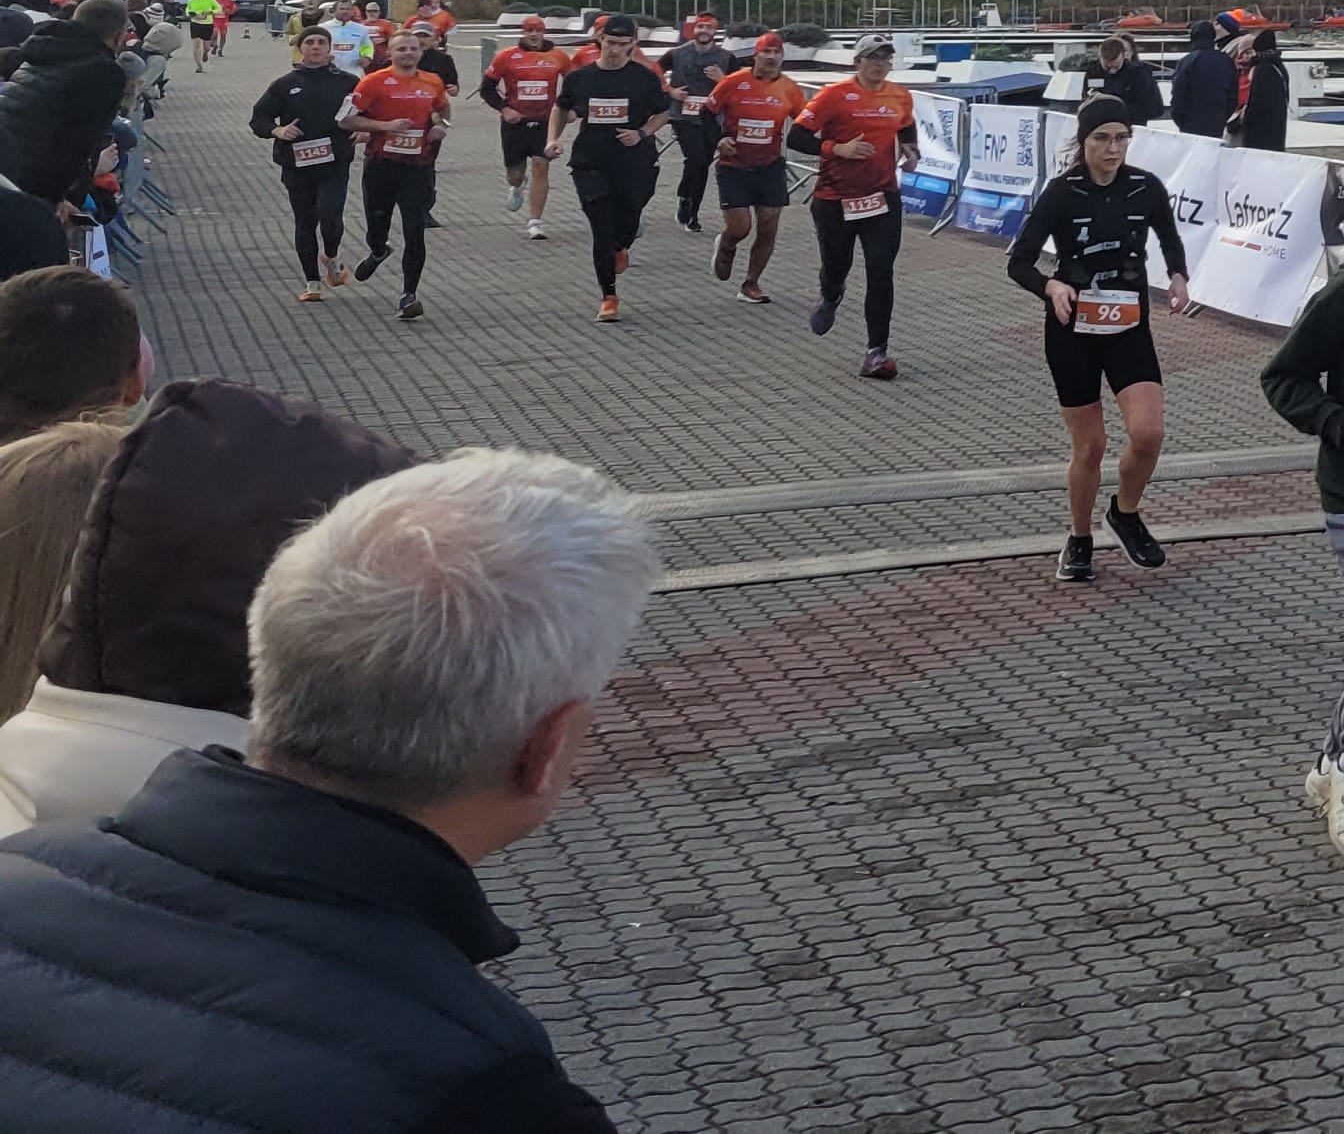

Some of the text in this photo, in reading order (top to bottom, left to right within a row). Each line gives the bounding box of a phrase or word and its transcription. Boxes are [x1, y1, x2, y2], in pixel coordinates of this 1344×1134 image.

[300, 146, 328, 159] 1145
[984, 133, 1008, 163] FNP
[849, 197, 881, 212] 1125
[1097, 304, 1122, 322] 96
